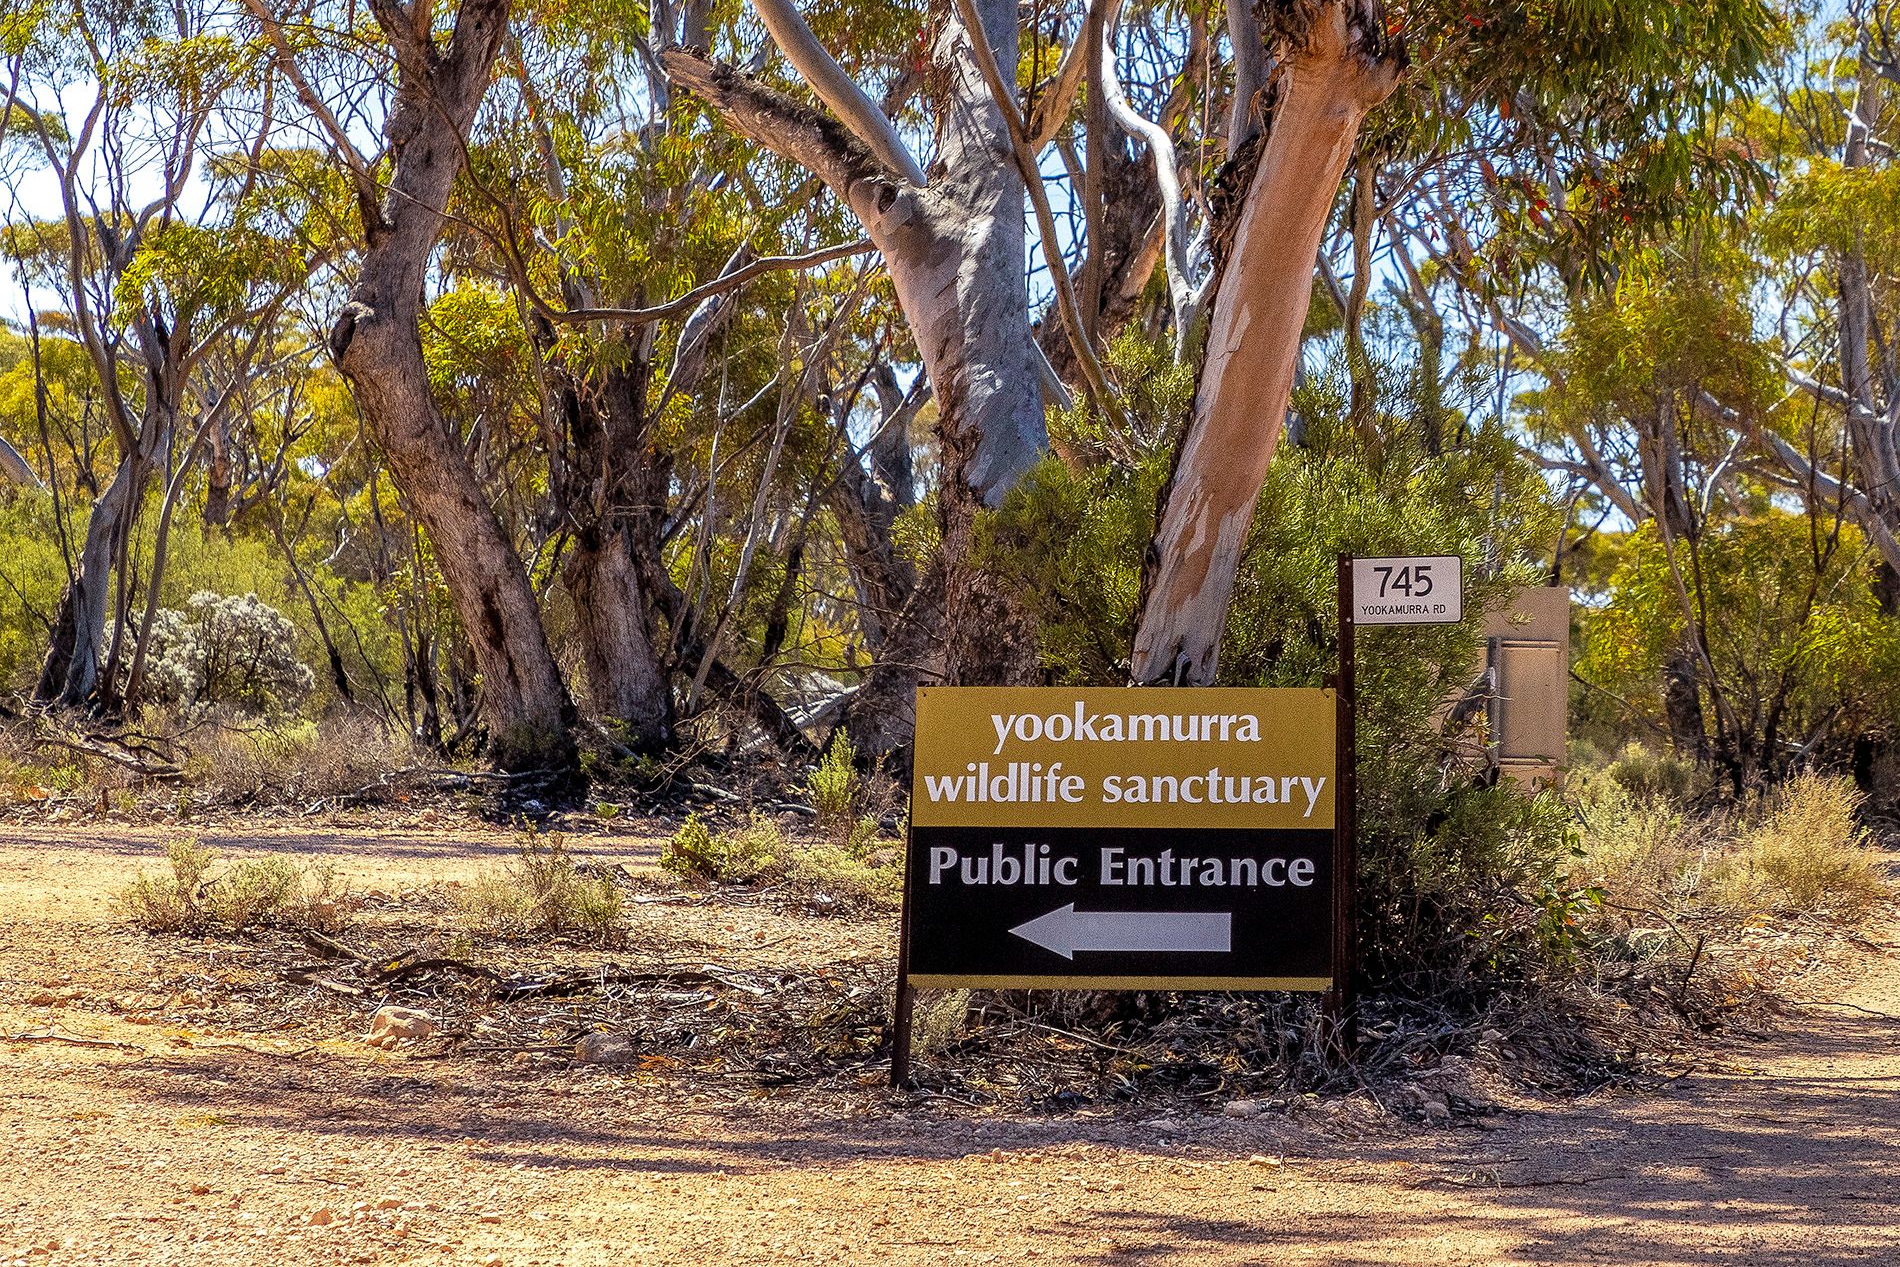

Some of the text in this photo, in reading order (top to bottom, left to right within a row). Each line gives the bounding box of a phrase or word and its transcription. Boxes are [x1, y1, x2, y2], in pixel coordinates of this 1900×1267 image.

[1373, 566, 1433, 597] 745
[1361, 604, 1446, 616] YOOKAMURRA RD
[990, 700, 1262, 755] yookamurra
[924, 762, 1327, 818] wildlife sanctuary
[928, 843, 1316, 888] Public Entrance
